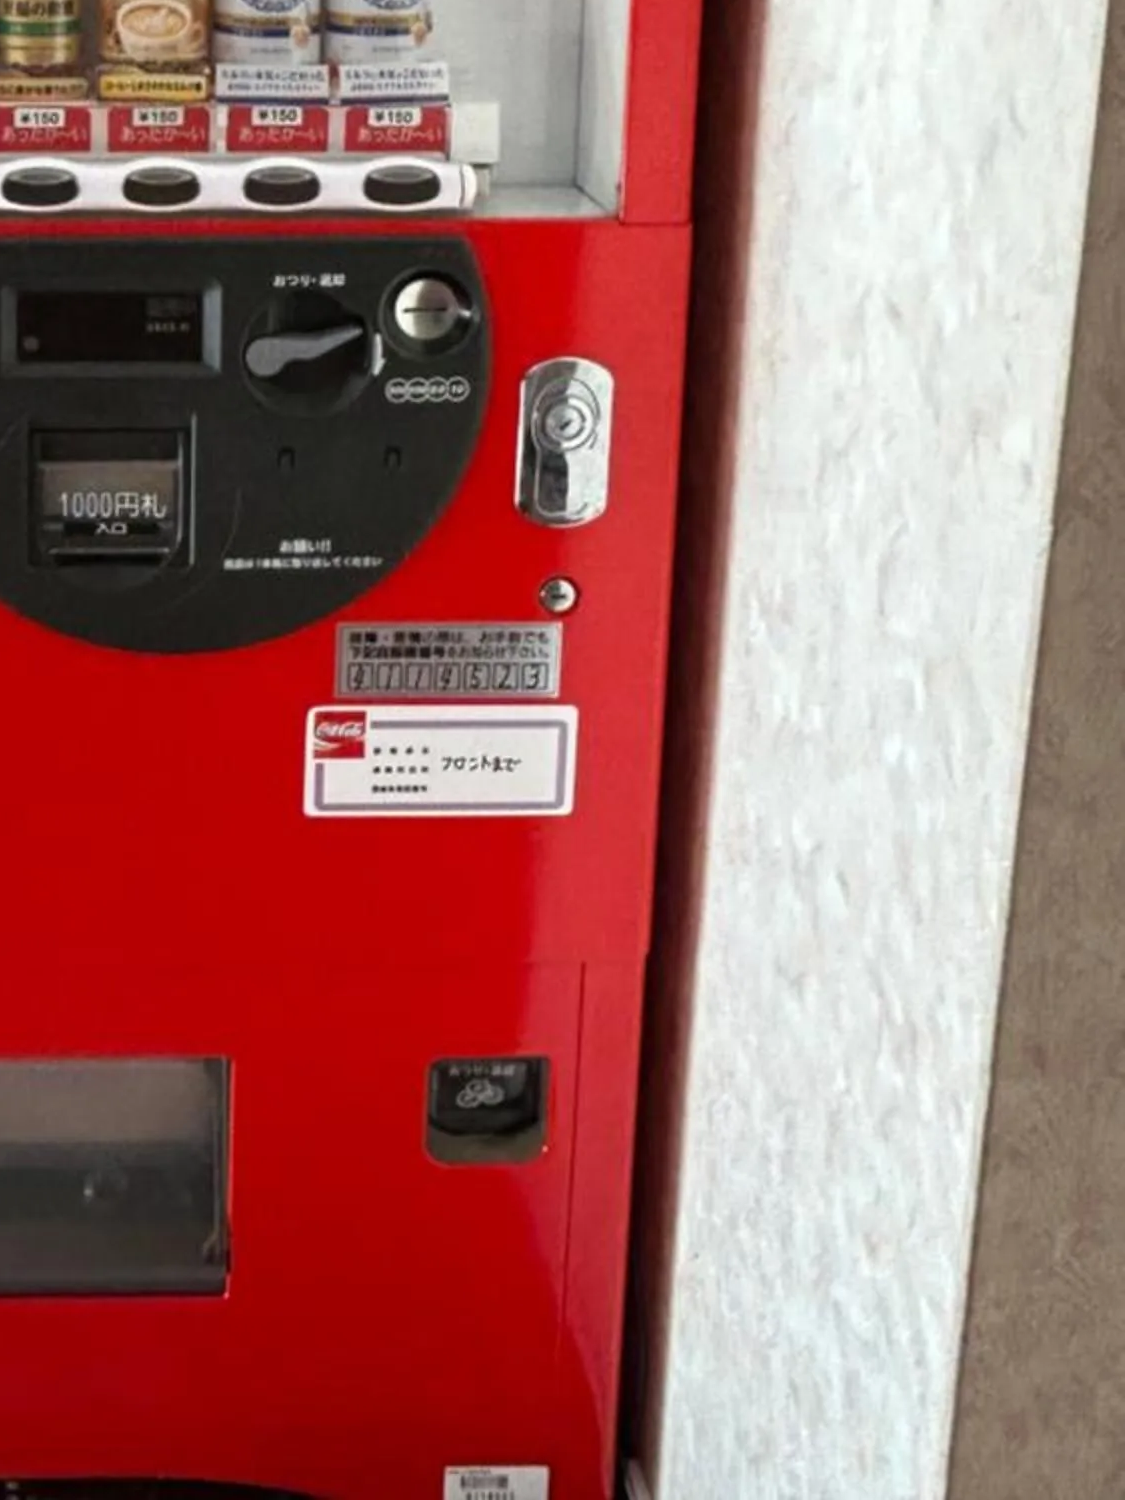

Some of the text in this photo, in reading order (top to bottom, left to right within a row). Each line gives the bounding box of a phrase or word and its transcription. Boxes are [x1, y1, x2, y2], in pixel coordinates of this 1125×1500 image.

[58, 491, 167, 519] 1000円札
[95, 522, 127, 534] 入口
[441, 755, 522, 772] フロントまで
